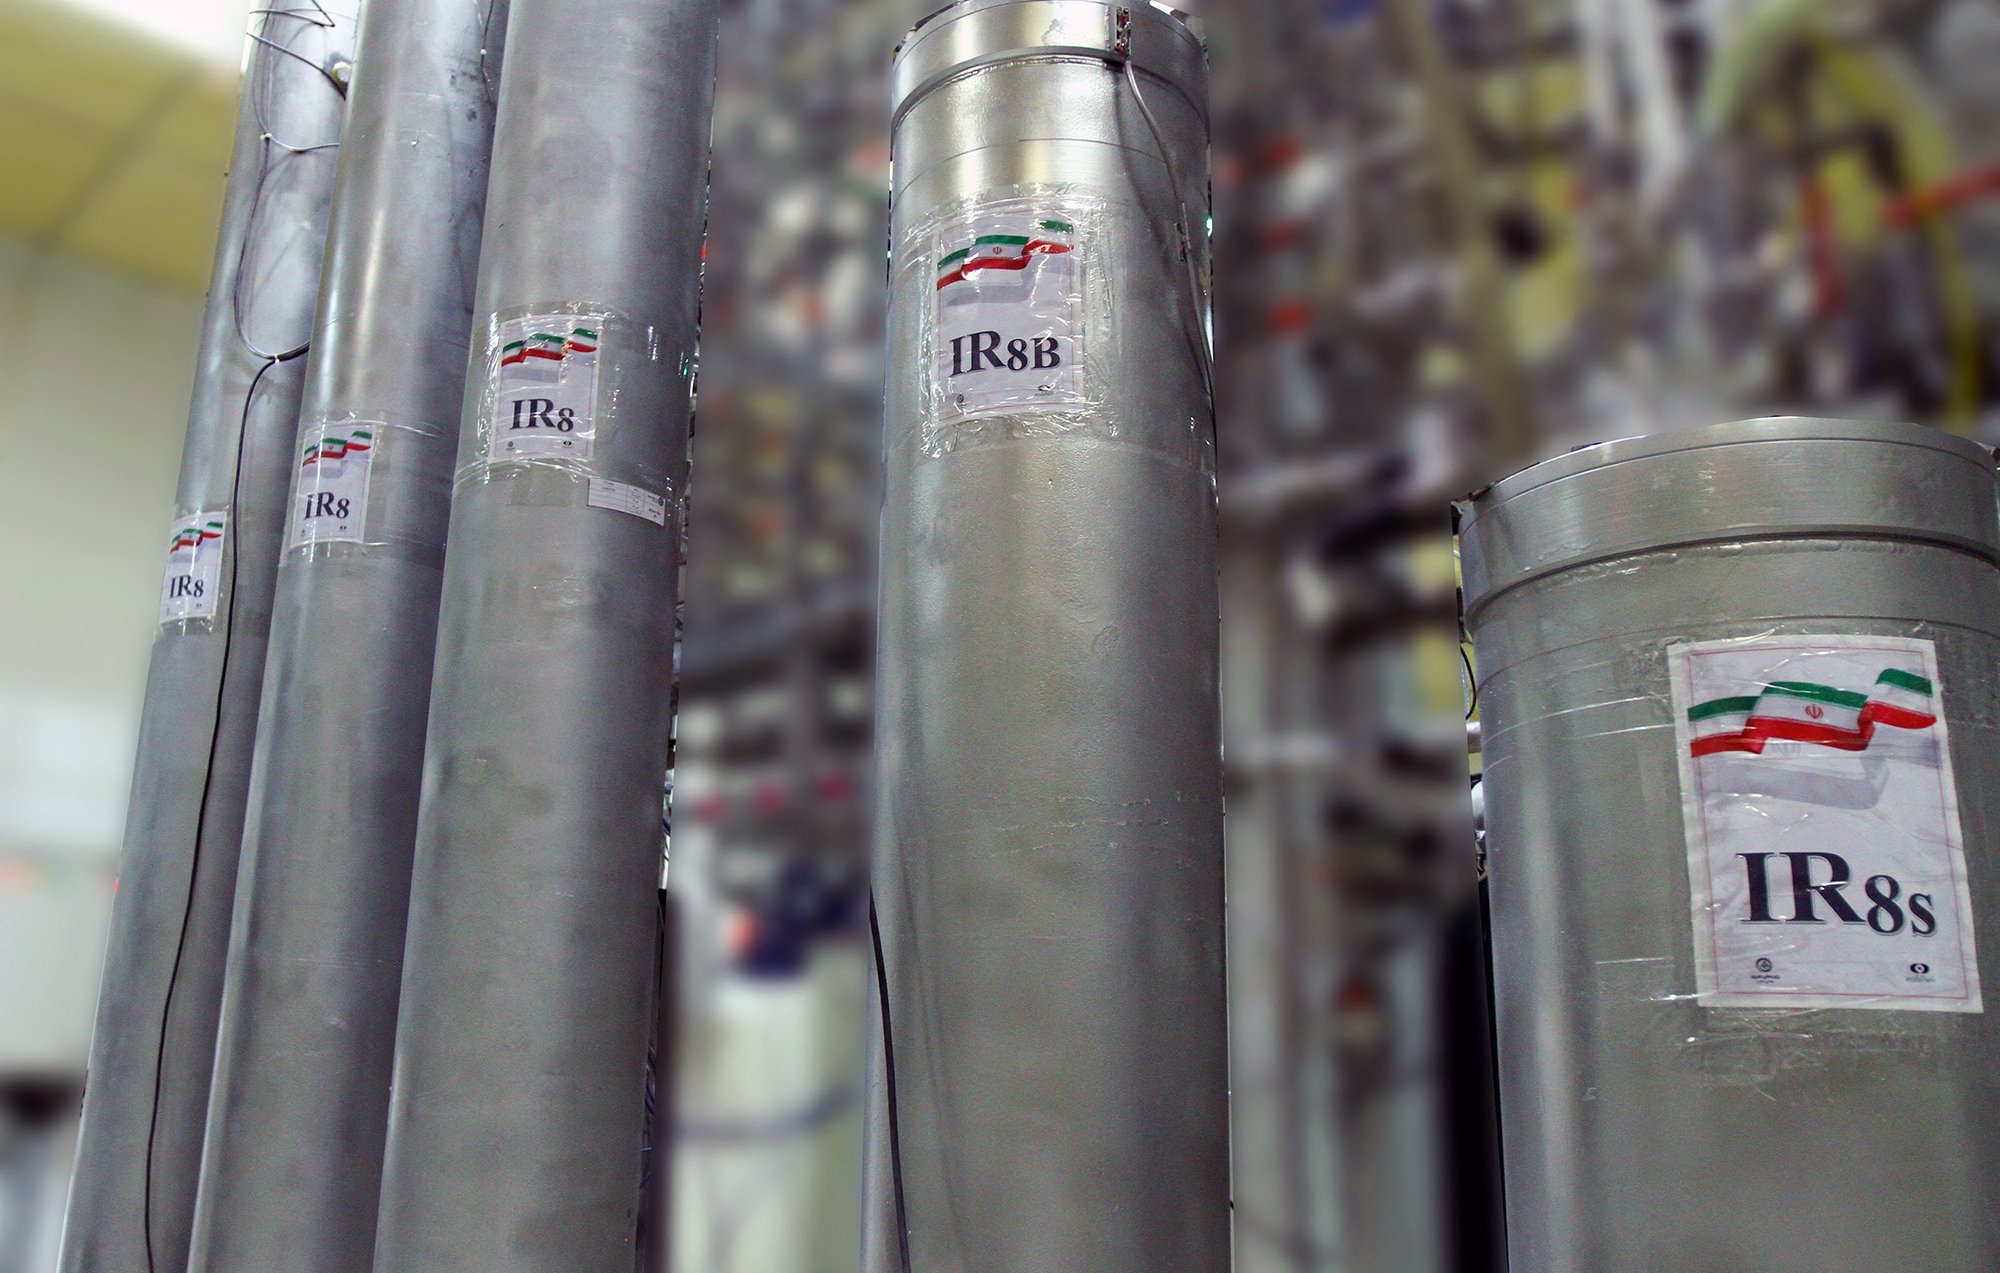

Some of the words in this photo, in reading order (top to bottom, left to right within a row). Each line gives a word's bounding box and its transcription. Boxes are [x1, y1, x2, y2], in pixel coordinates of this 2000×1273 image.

[949, 330, 1060, 377] IR8B
[509, 398, 574, 432] IR8
[169, 574, 204, 598] IR8
[1736, 851, 1936, 937] IR8s
